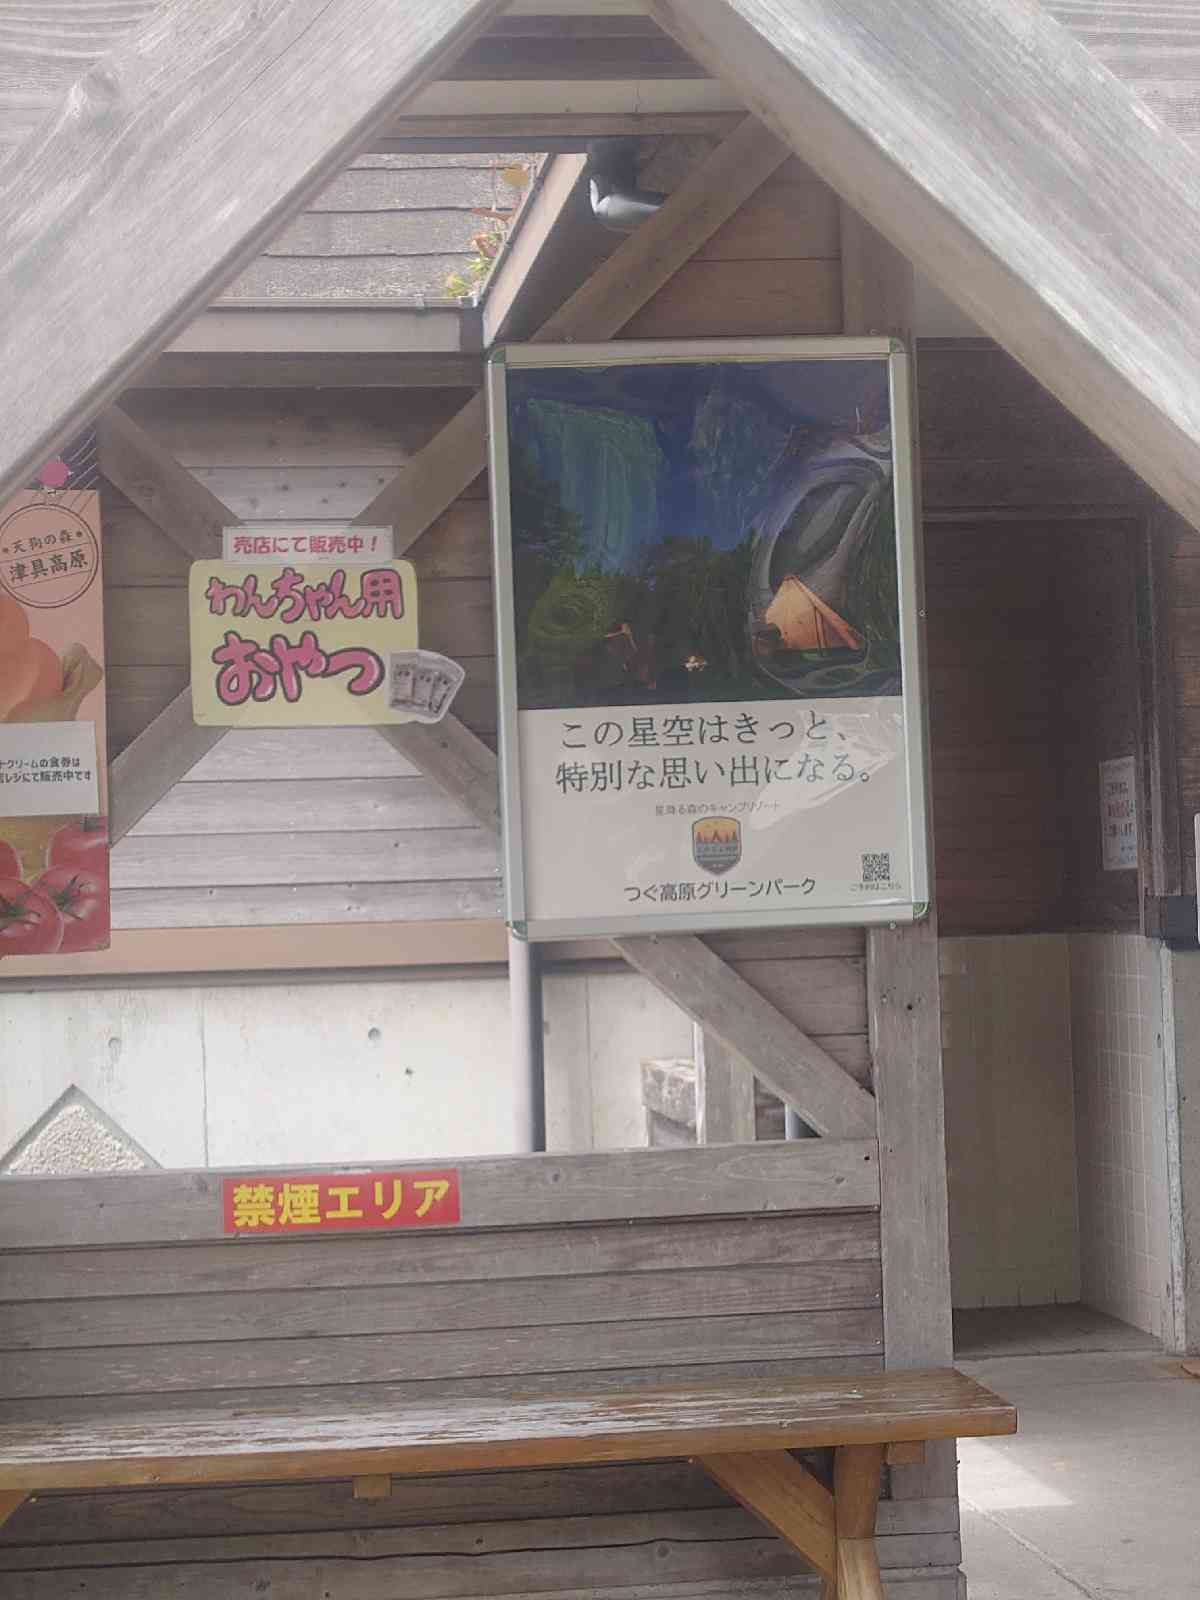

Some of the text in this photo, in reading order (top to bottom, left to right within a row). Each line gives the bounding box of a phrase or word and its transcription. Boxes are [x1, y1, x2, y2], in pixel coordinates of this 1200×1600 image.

[12, 528, 73, 554] 天狗の森
[233, 535, 379, 554] 売店にて販売中！
[9, 549, 88, 583] 津具高原
[204, 566, 405, 624] わんちゃん用
[211, 630, 386, 706] おやつ
[561, 710, 849, 750] この星空はきっと、
[555, 752, 871, 794] 特別な思い出になる。
[624, 878, 817, 903] つぐ高原グリーンパーク
[233, 1179, 450, 1227] 禁煙エリア
